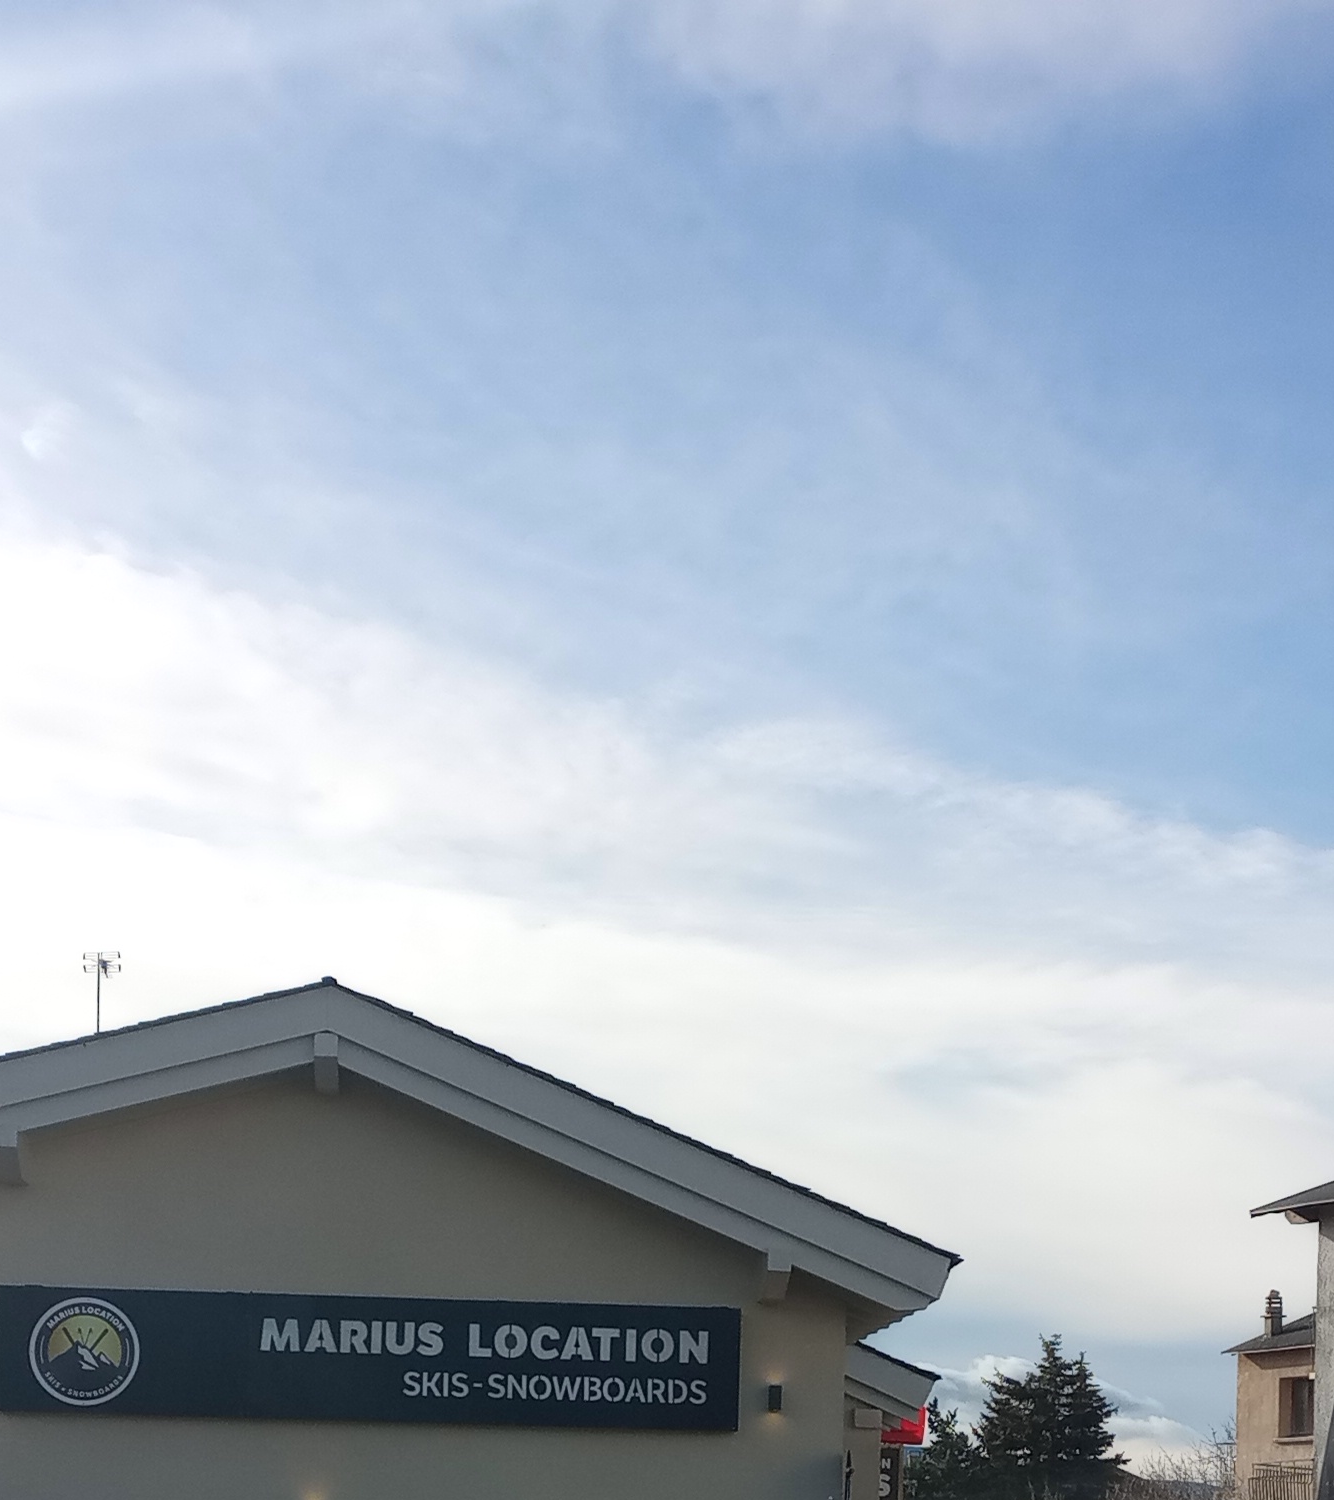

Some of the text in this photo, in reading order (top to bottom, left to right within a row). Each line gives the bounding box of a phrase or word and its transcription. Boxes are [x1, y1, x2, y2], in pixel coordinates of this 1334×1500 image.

[47, 1306, 126, 1332] MARIUS LOCATION
[259, 1317, 709, 1364] MARIUS LOCATION
[45, 1371, 124, 1398] SKIS SNOWBOARDS
